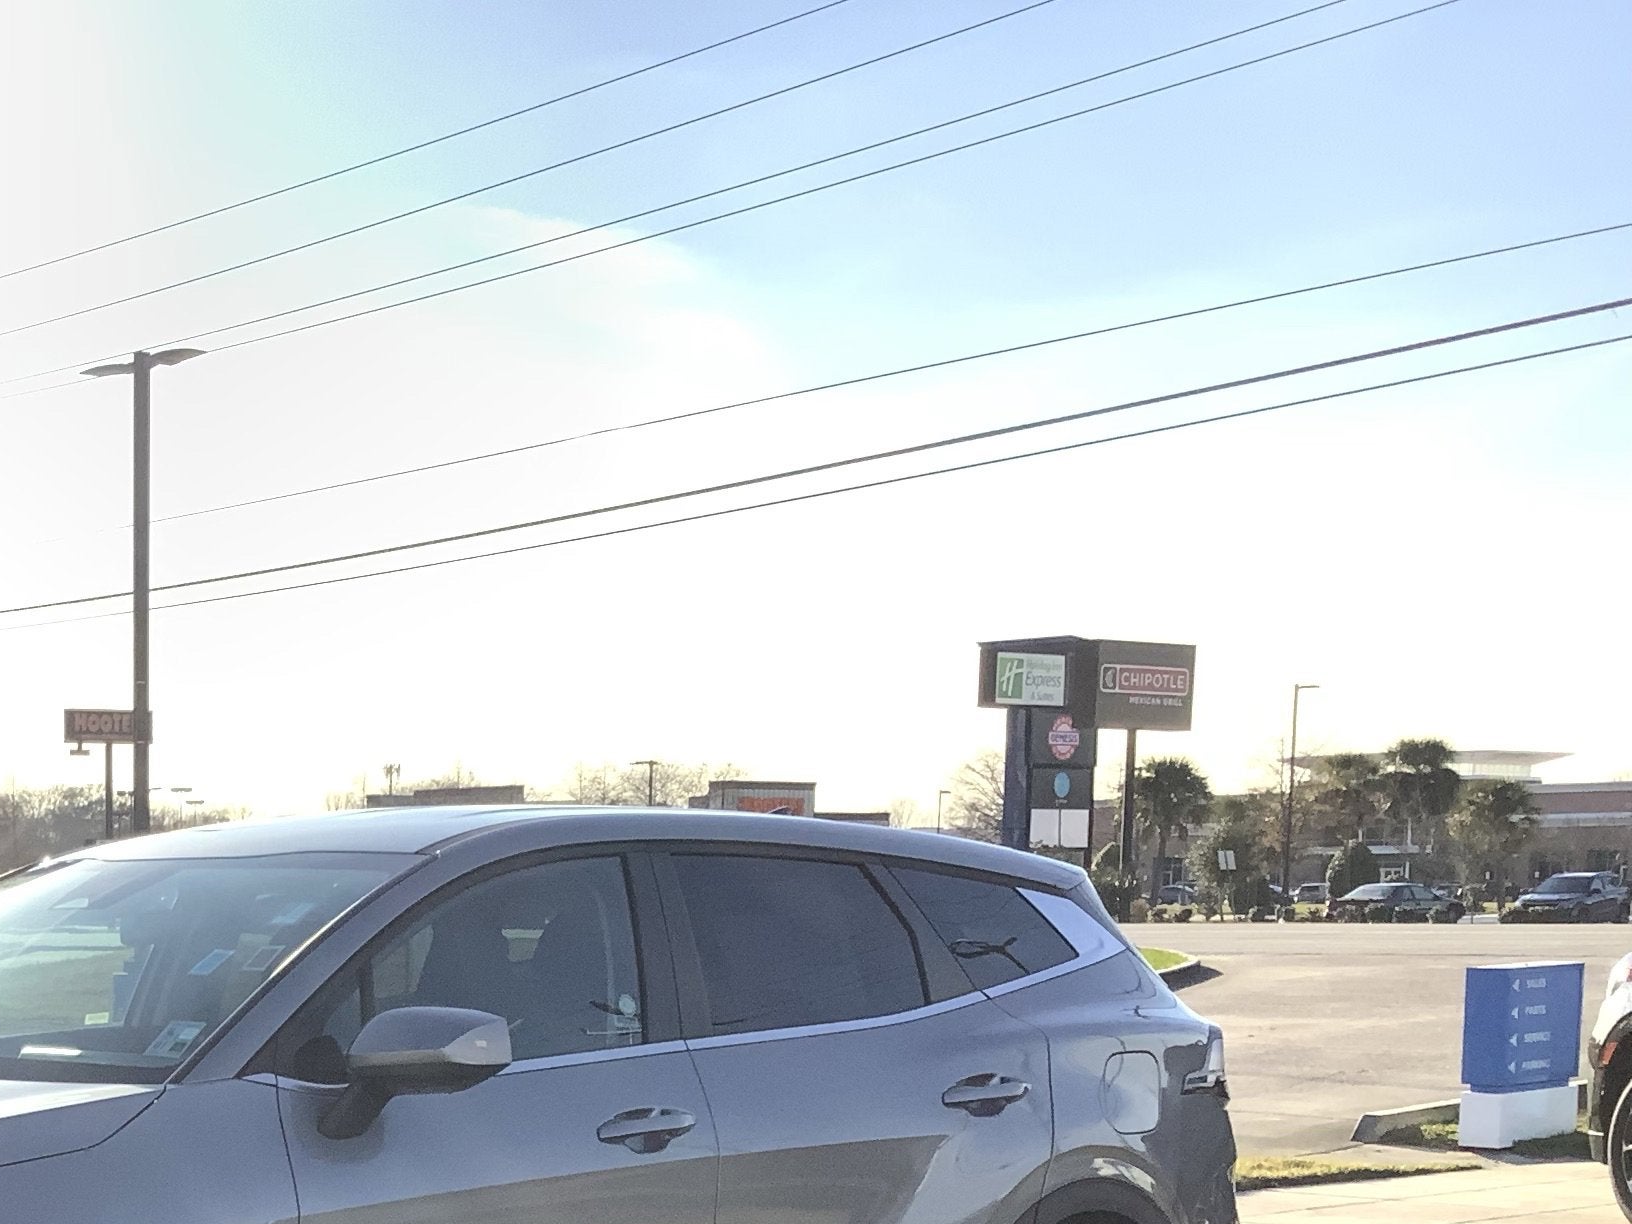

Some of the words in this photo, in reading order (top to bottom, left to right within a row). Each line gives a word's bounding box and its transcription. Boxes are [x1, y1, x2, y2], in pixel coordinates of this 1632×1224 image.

[1025, 671, 1062, 689] Express
[1121, 672, 1185, 689] CHIPOTLE
[1129, 696, 1162, 705] MEXICAN
[1163, 697, 1184, 707] GRILL
[74, 713, 133, 733] HOOTE
